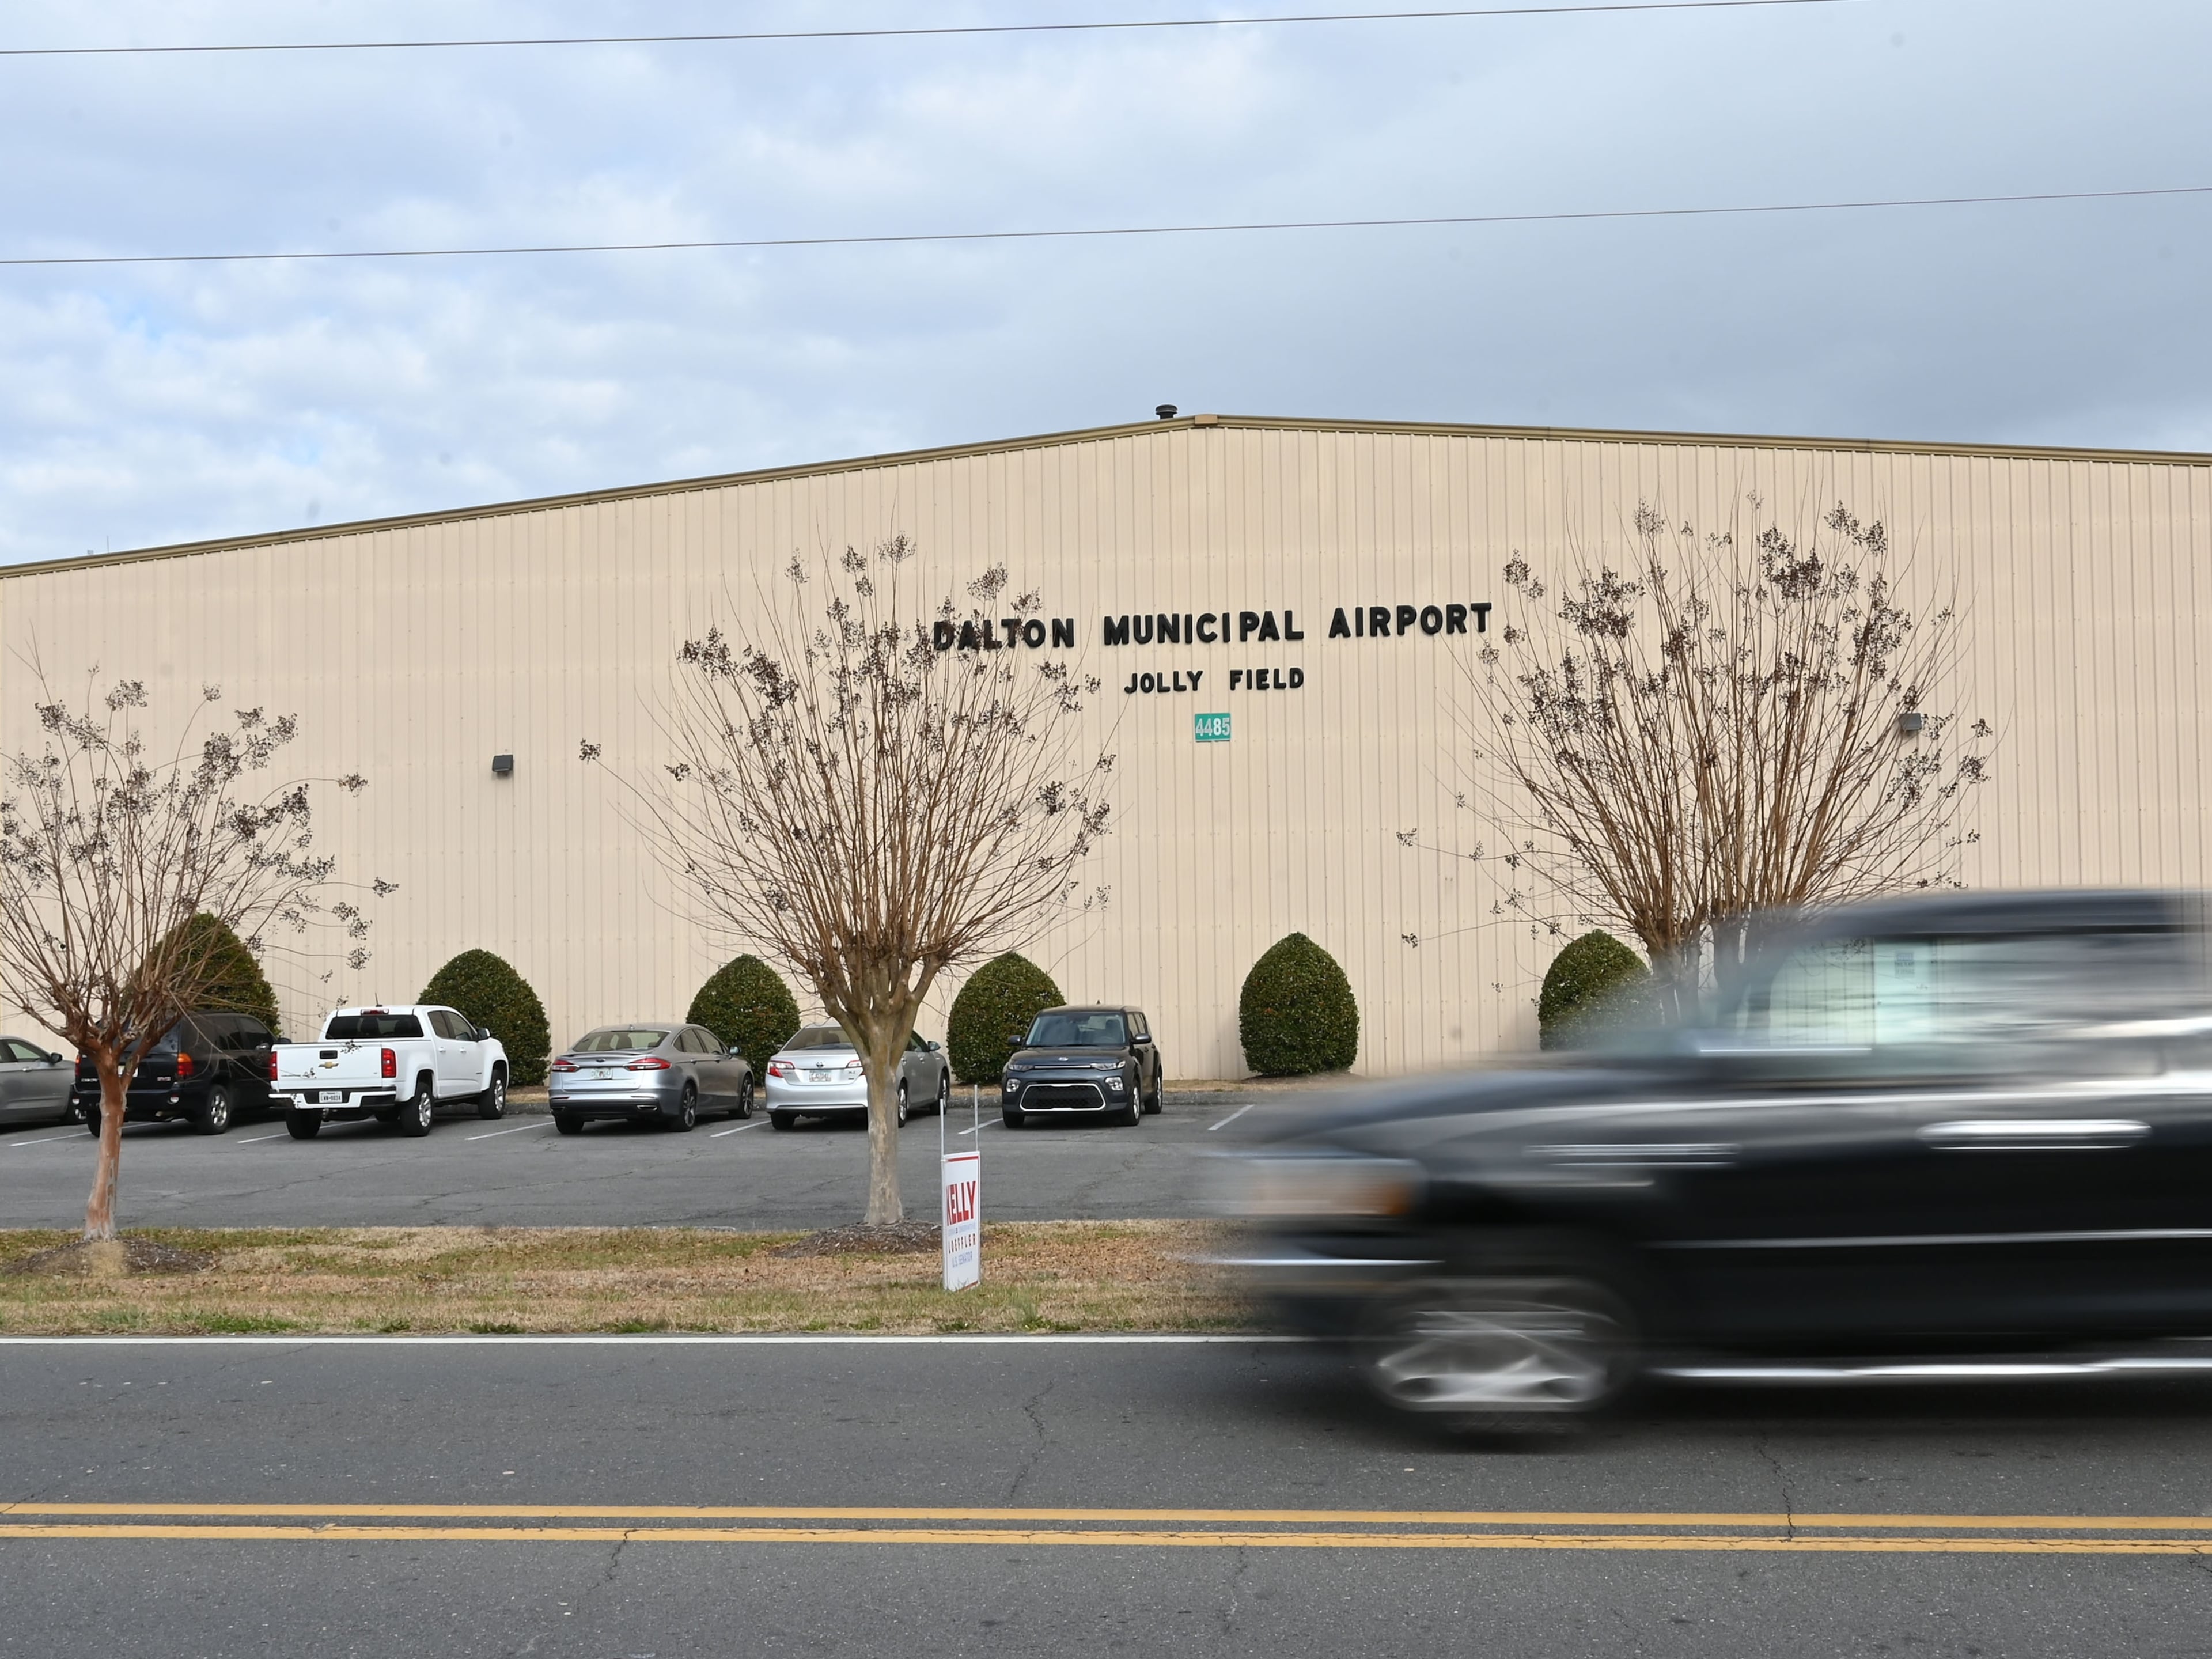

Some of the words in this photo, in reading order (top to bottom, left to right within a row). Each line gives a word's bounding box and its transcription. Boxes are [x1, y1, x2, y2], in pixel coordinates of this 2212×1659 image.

[934, 618, 1074, 651] DALTON
[1104, 610, 1304, 646] MUNICIPAL
[1328, 602, 1493, 639] AIRPORT
[1124, 670, 1203, 694] JOLLY
[1229, 667, 1304, 691] FIELD
[1195, 718, 1230, 737] 4485
[946, 1180, 976, 1226] KELLY
[948, 1233, 976, 1255] LOEFFLER
